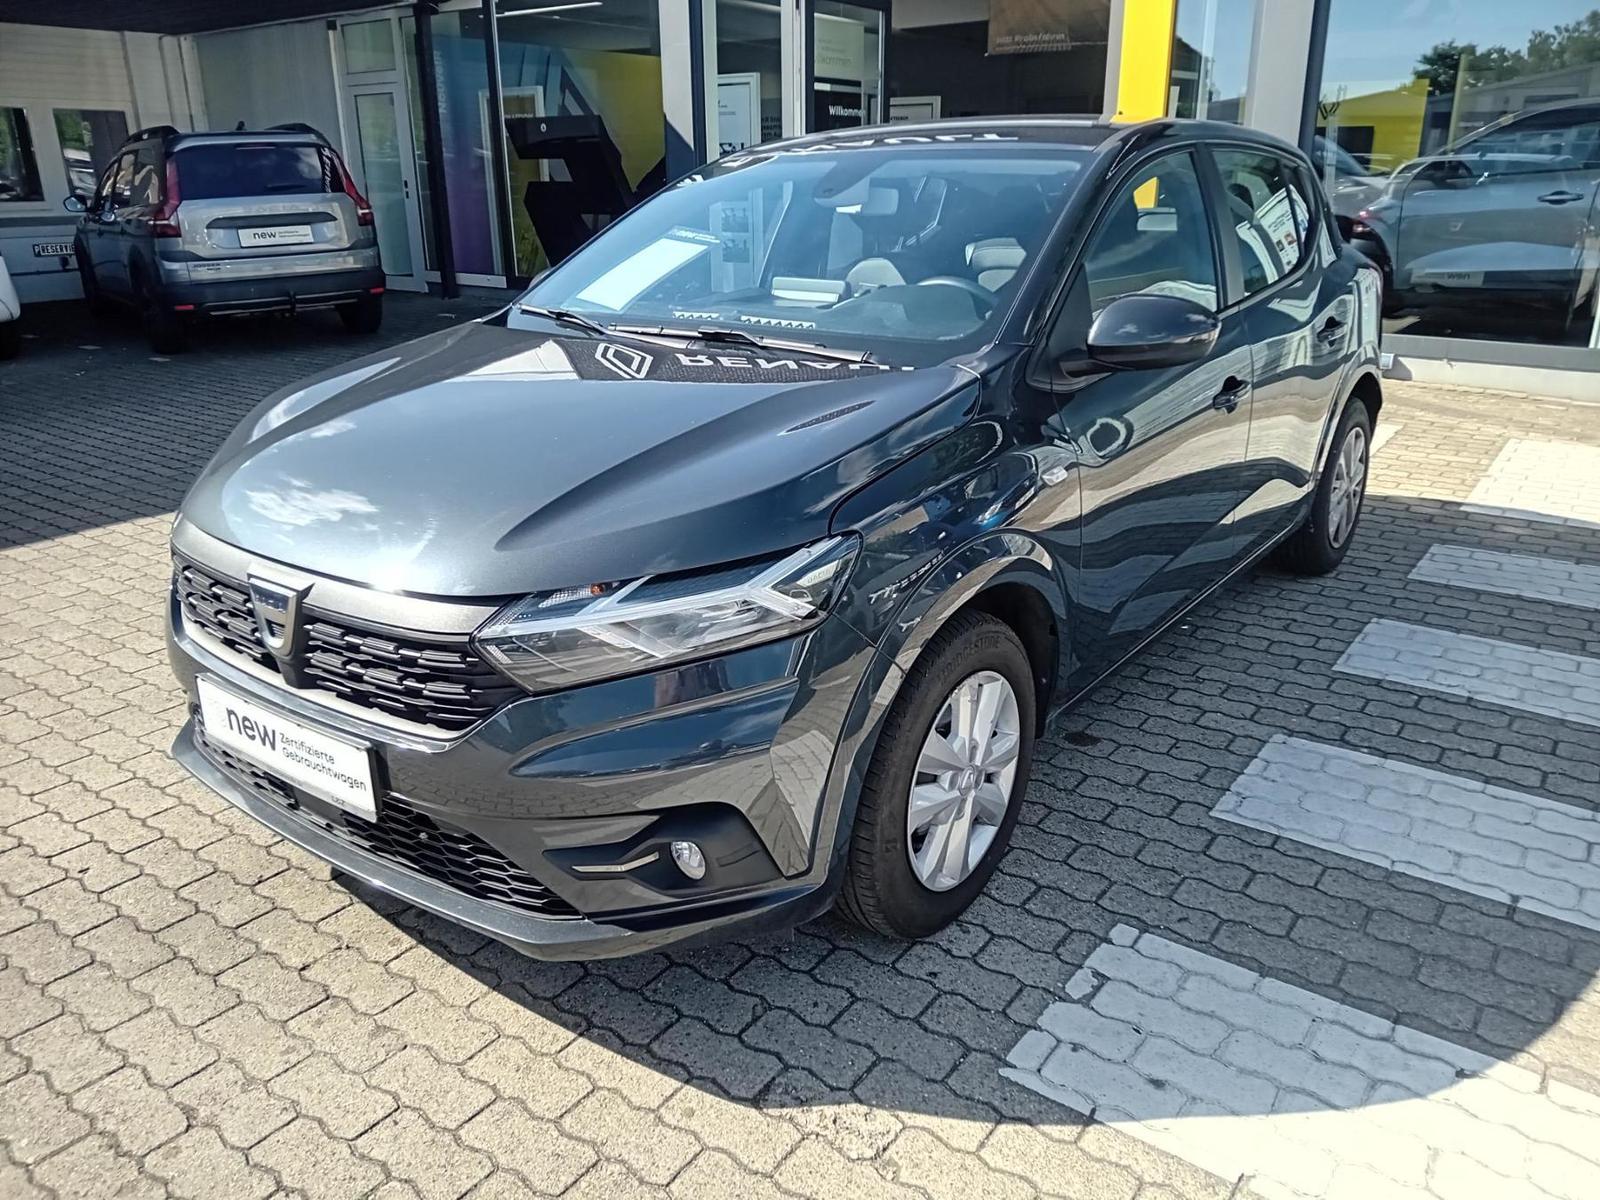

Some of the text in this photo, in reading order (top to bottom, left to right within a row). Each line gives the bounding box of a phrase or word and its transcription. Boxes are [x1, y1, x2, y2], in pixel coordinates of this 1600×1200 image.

[41, 243, 77, 255] RESERVIE
[252, 230, 277, 240] new
[225, 706, 335, 765] new Zertifizierte
[282, 746, 367, 792] Gebrauchtwagen
